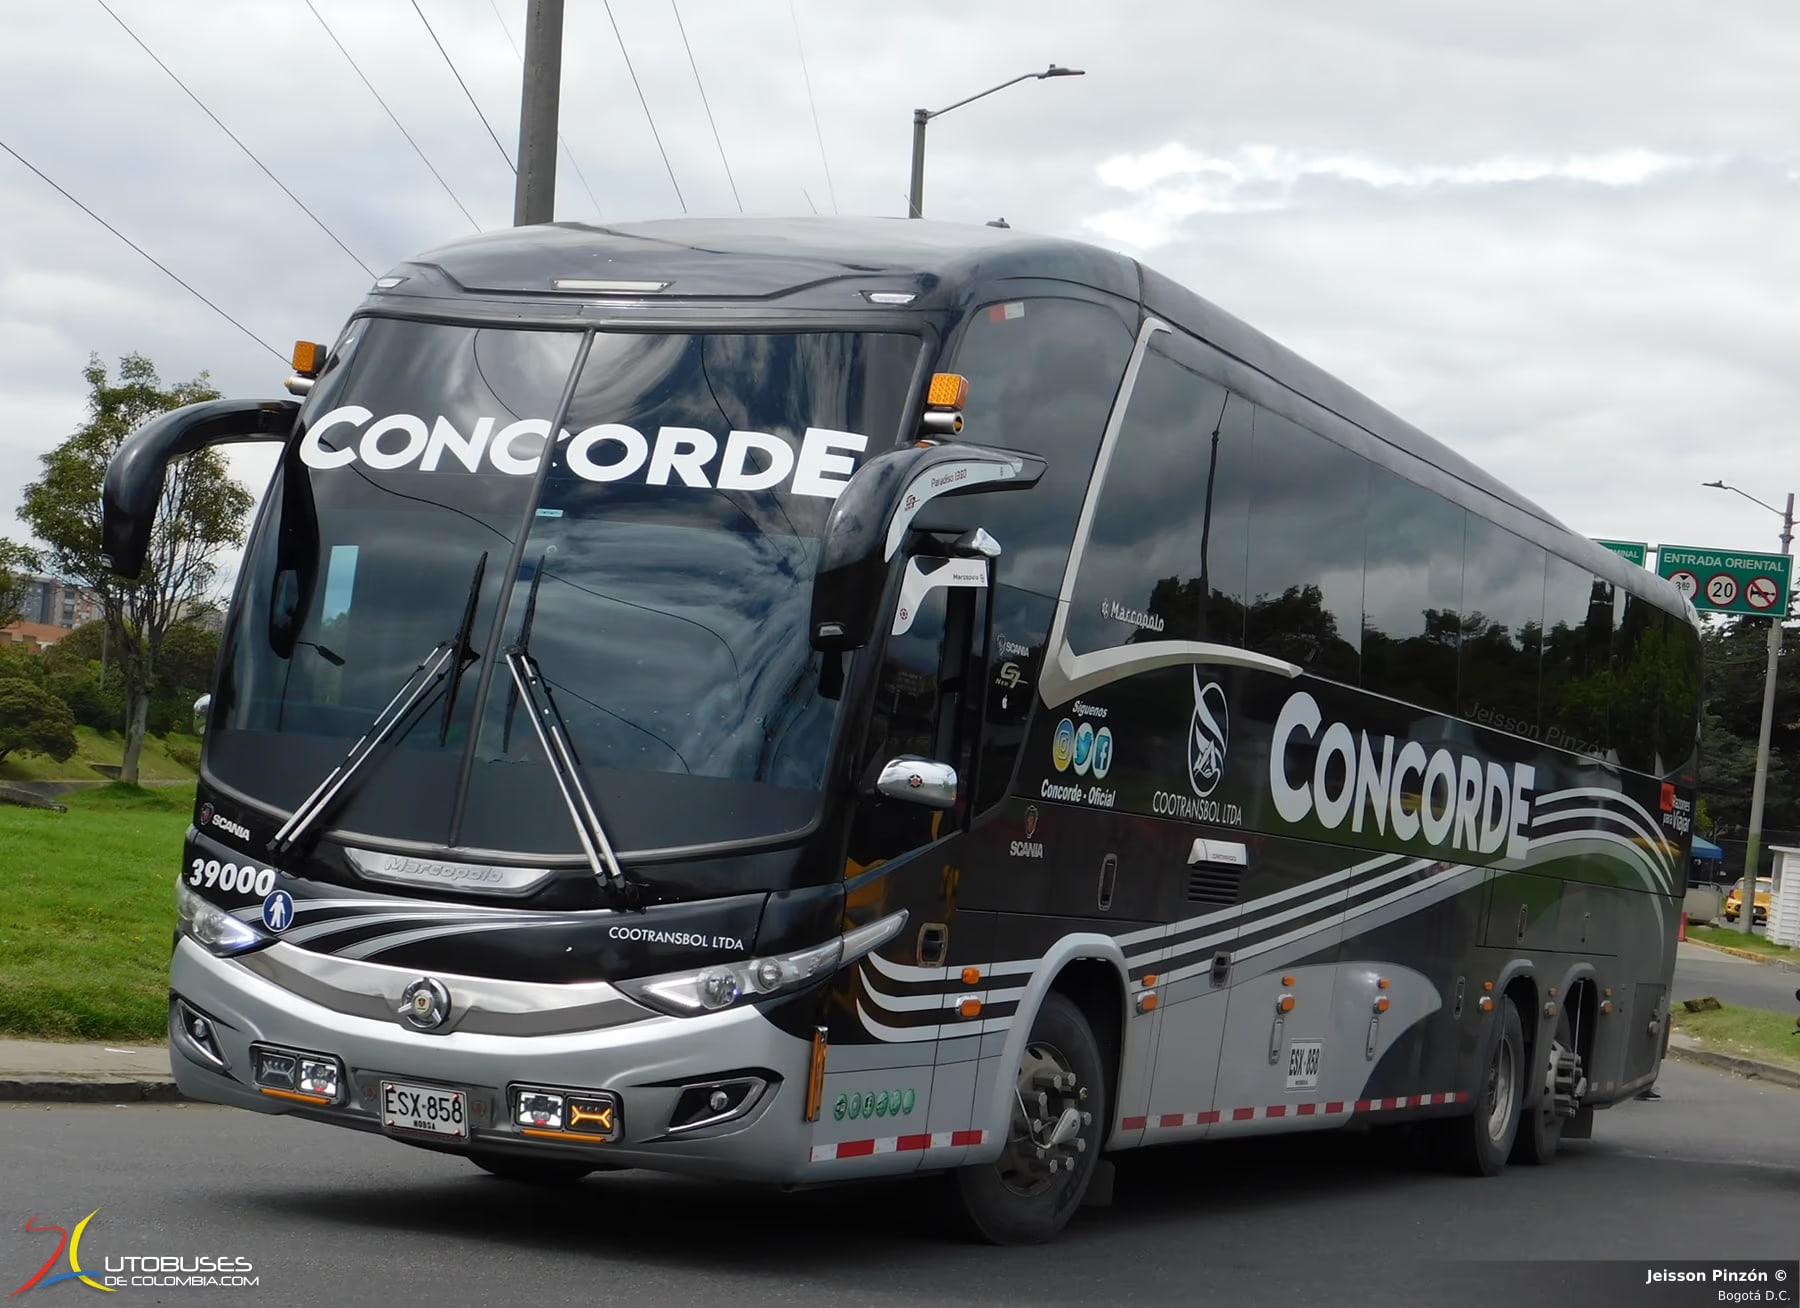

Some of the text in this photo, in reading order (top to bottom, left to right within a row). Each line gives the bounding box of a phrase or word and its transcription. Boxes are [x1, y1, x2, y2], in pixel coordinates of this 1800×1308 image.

[299, 405, 869, 498] CONCORDE
[1664, 552, 1785, 572] ENTRADA ORIENTAL
[1712, 582, 1733, 598] 20
[1110, 601, 1165, 632] Marcopolo
[1006, 641, 1029, 658] SCANIA
[1270, 691, 1536, 861] CONCORDE
[1041, 779, 1081, 803] Concorde
[1088, 786, 1116, 808] Oficial
[1153, 791, 1242, 826] COOTRANSBOL LTDA
[212, 813, 251, 842] SCANIA
[1010, 841, 1043, 859] SCANIA
[189, 858, 276, 897] 39000
[385, 857, 504, 884] Marcopolo
[609, 927, 744, 951] COOTRANSBOL LTDA
